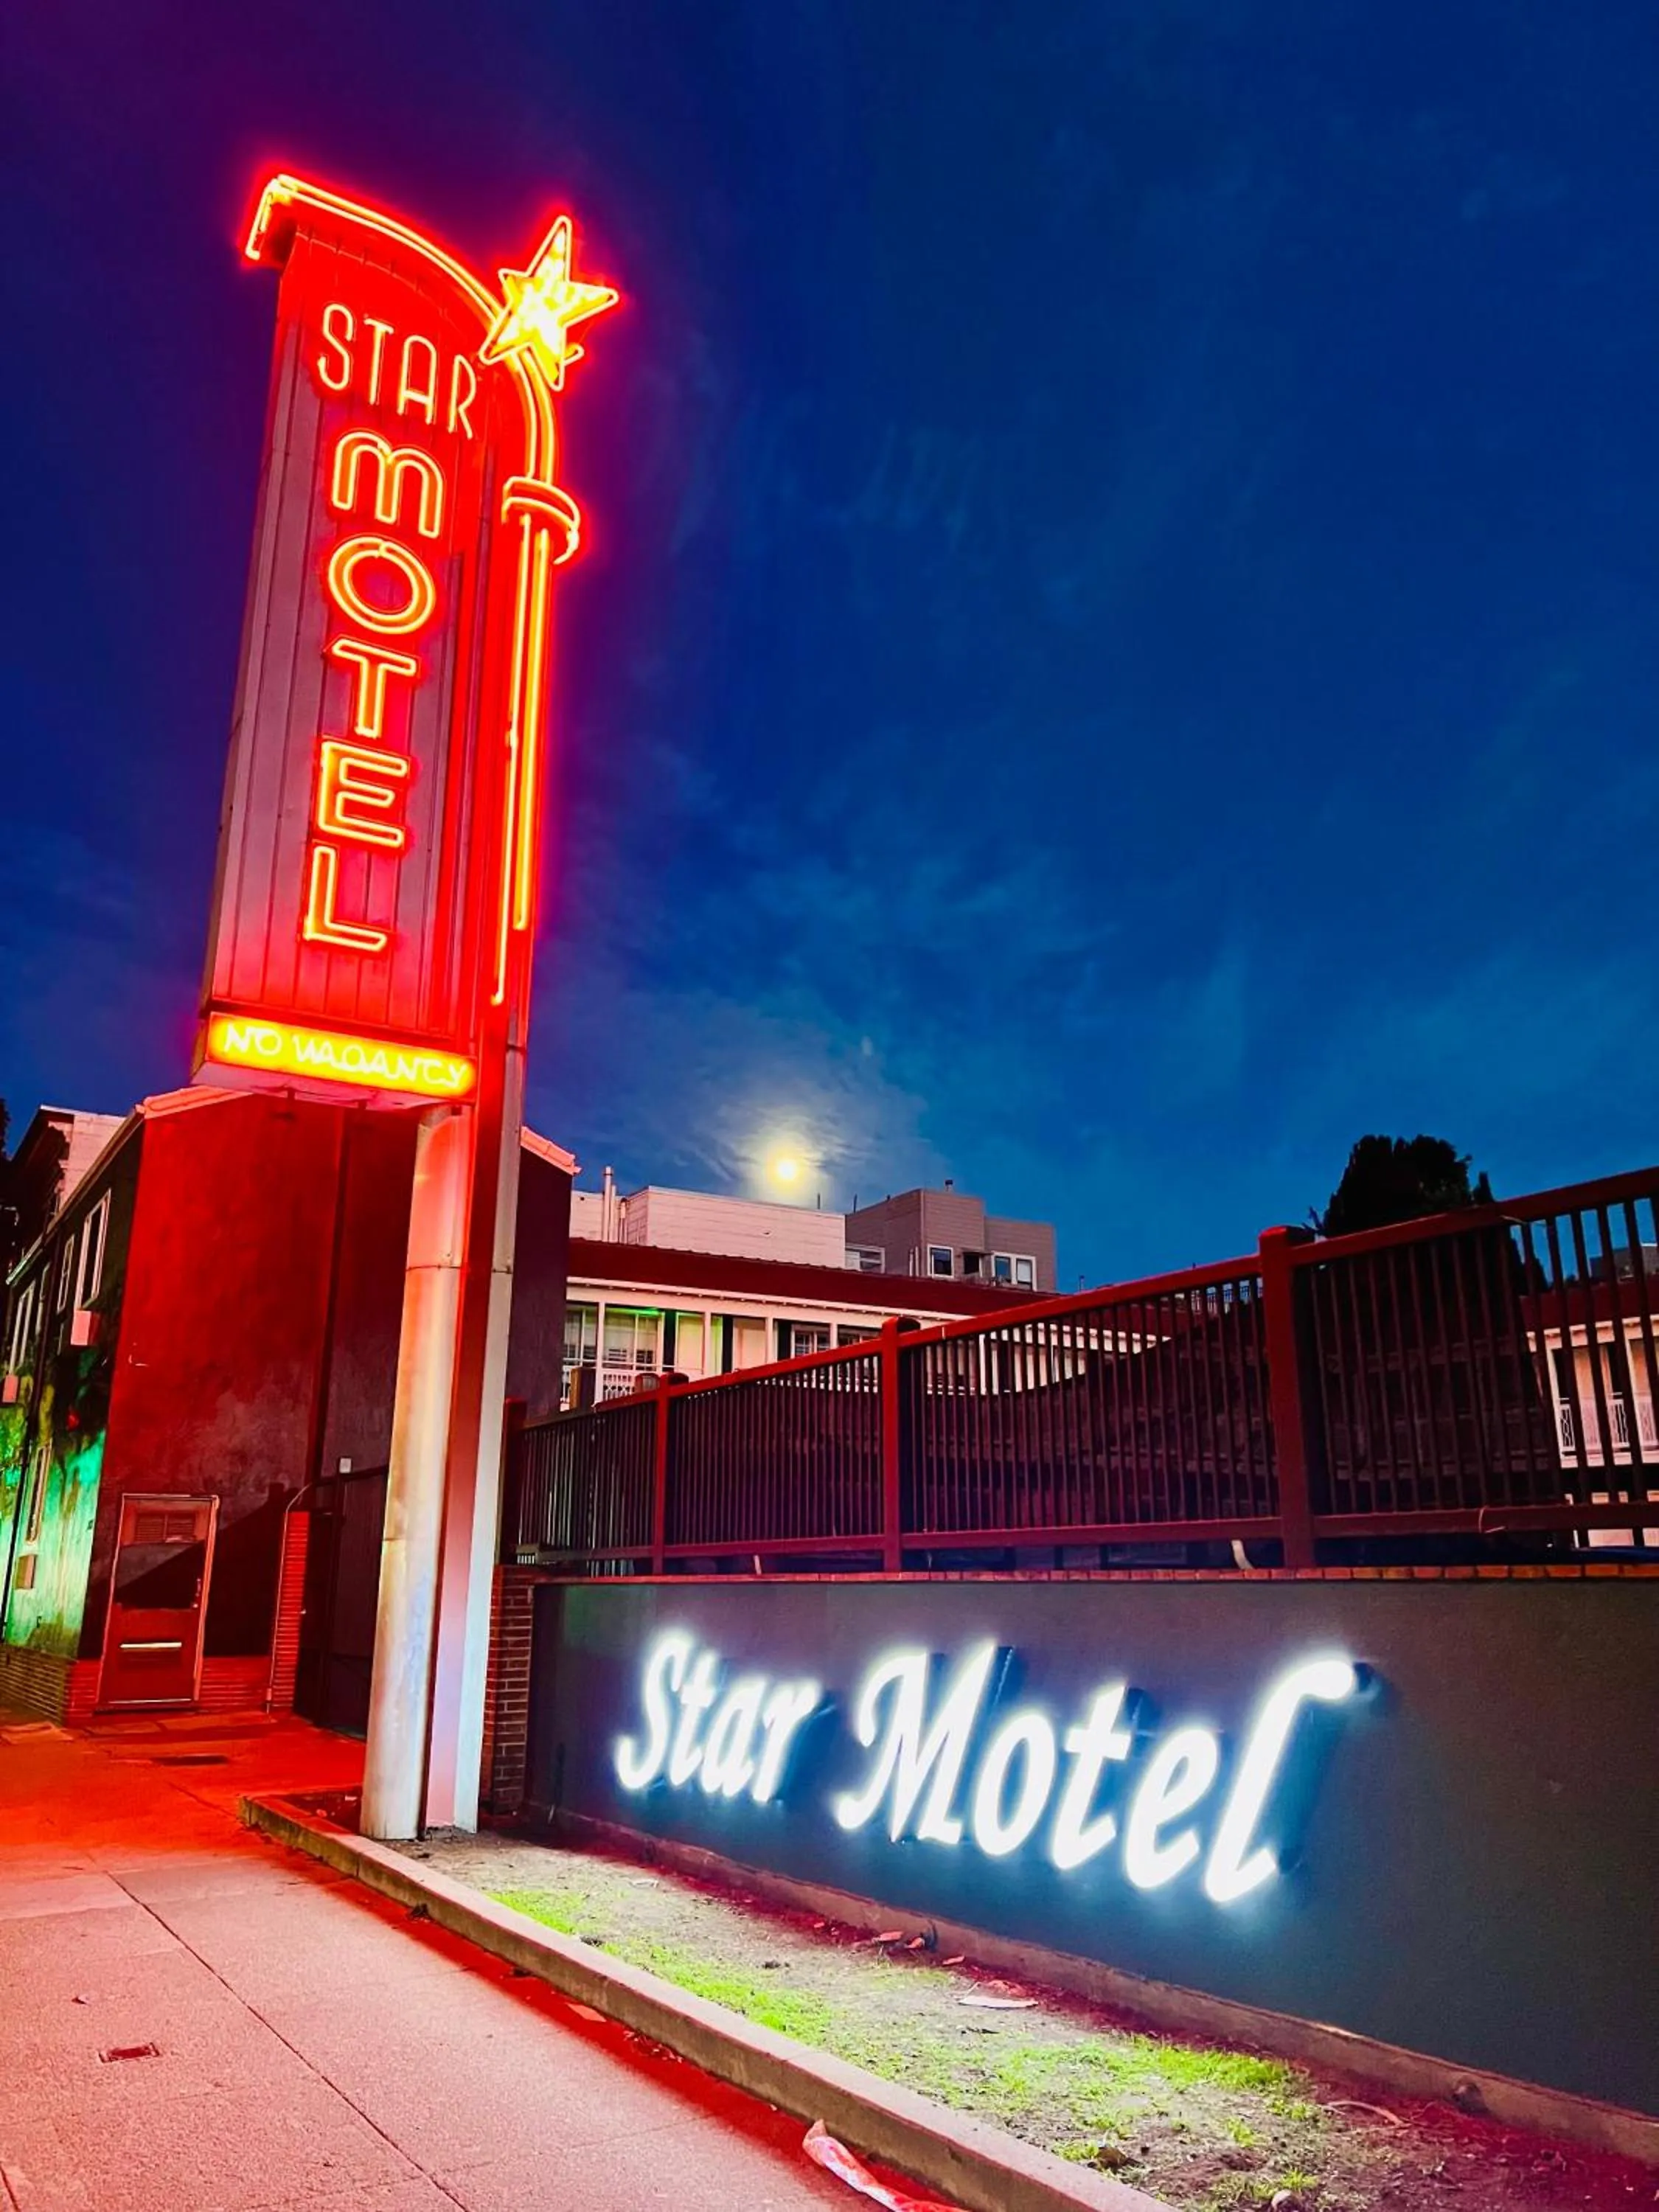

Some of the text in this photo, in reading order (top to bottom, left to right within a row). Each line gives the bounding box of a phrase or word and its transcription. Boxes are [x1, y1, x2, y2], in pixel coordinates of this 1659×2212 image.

[316, 302, 478, 440] STAR
[302, 431, 445, 953] MOTEL
[223, 1022, 283, 1057] NO
[615, 1631, 1355, 1904] Star Motel
